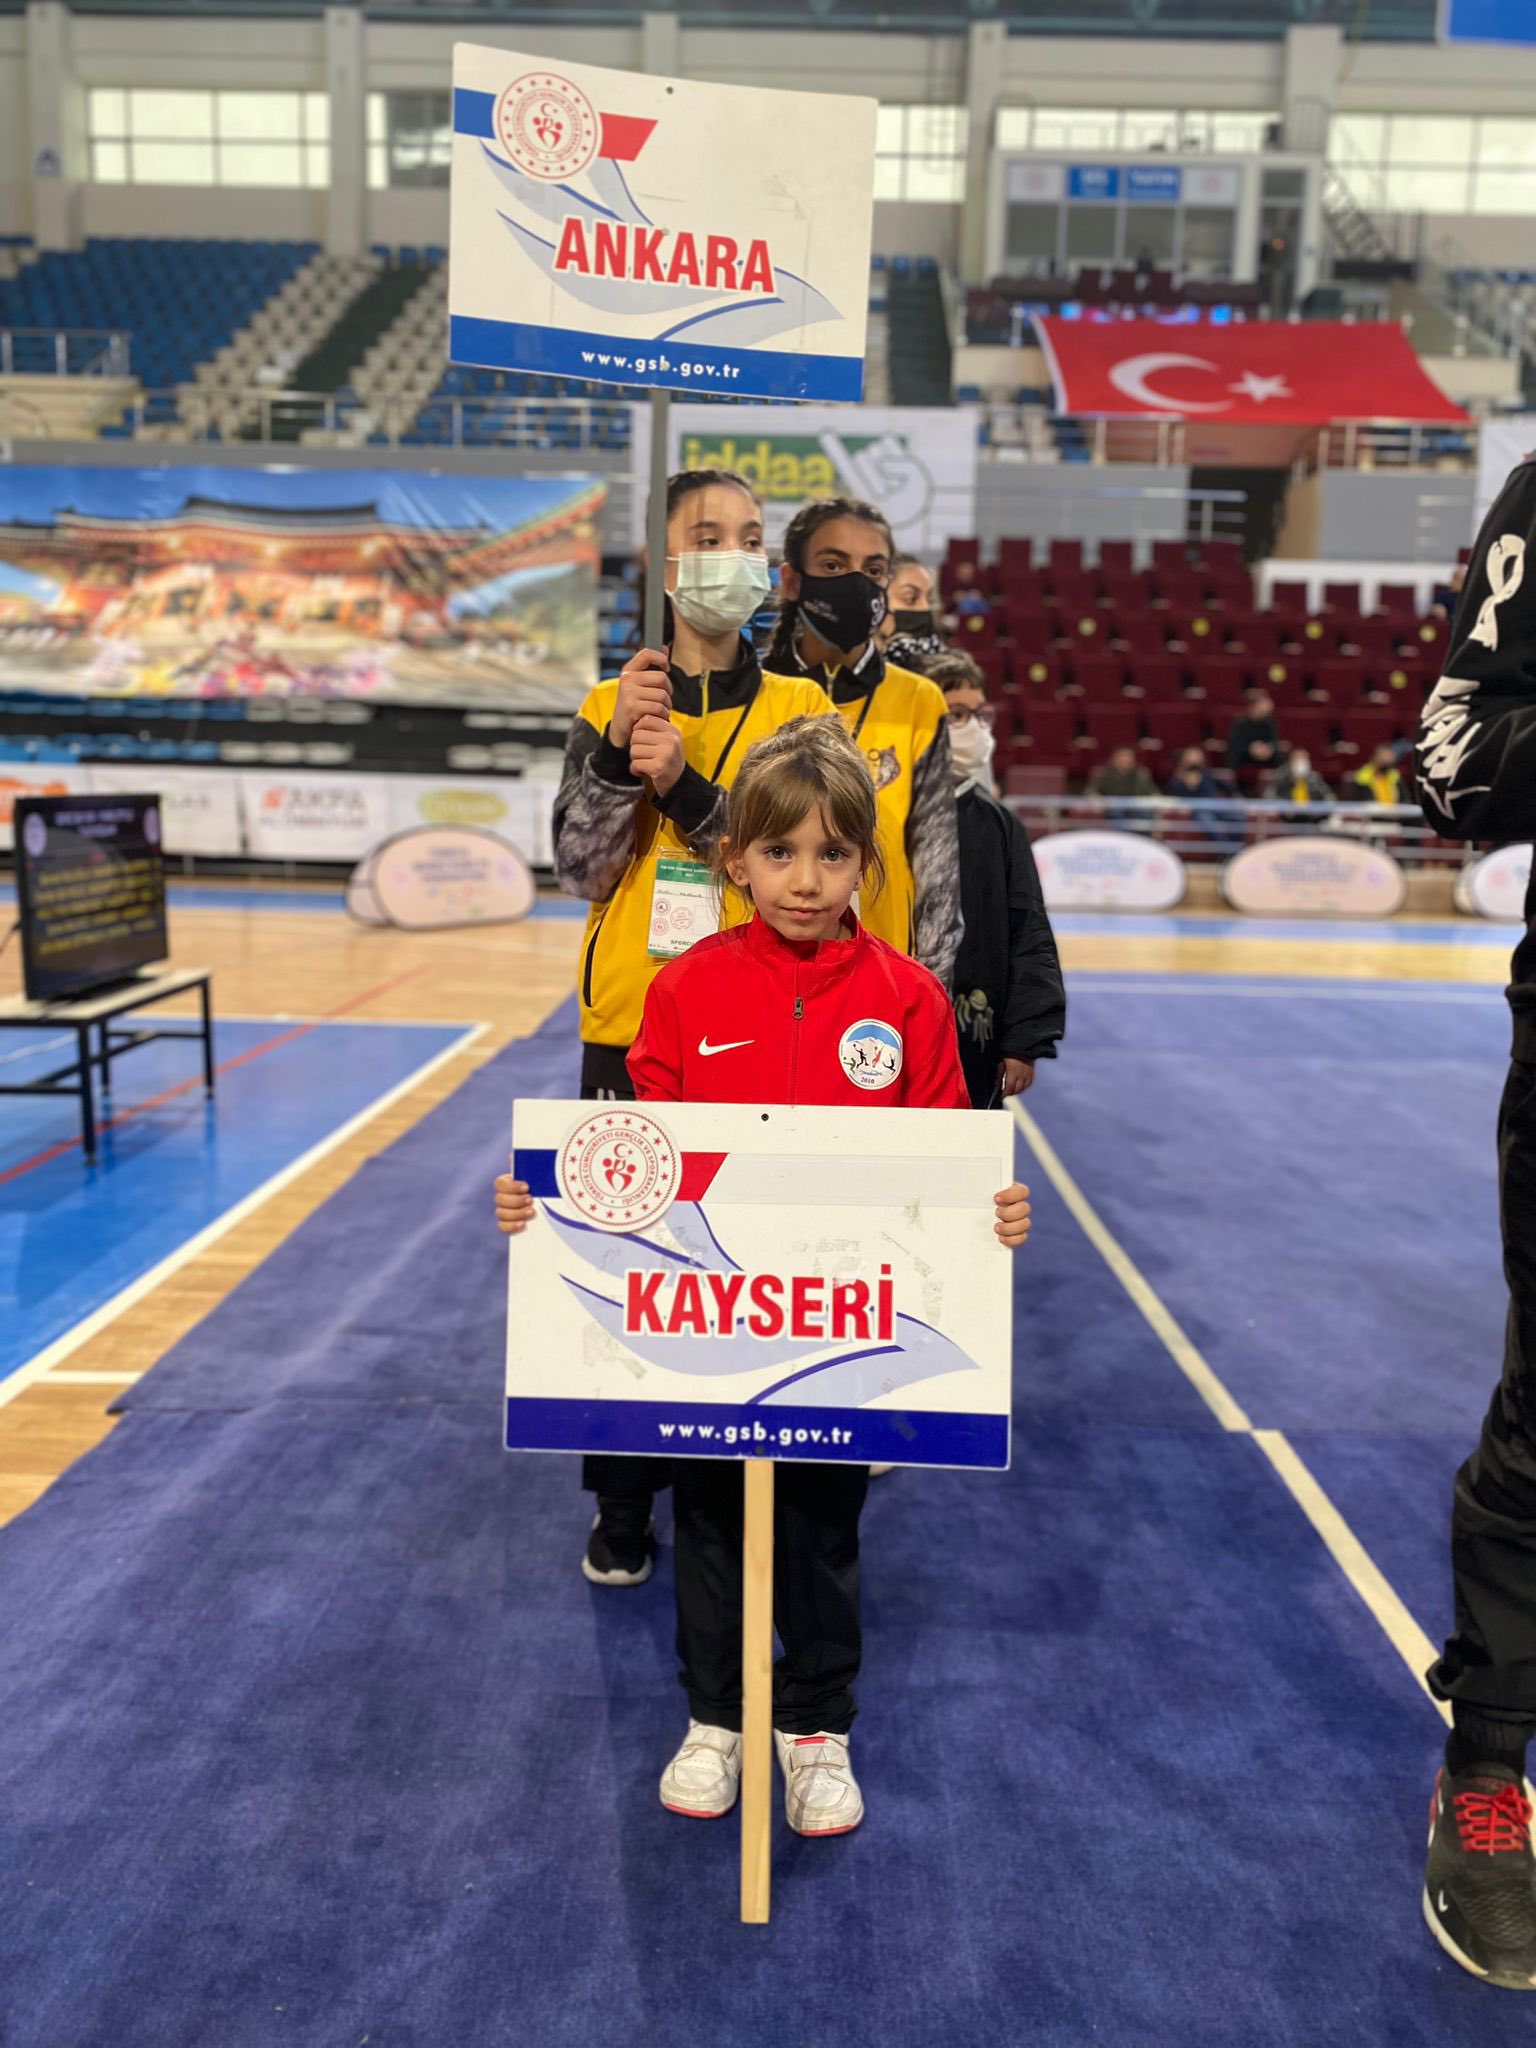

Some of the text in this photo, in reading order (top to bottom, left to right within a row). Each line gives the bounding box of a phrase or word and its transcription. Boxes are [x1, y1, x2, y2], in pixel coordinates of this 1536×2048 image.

[554, 217, 775, 293] ANKARA
[581, 351, 740, 379] www.gsb.gov.tr
[860, 1076, 875, 1084] 2010
[614, 1131, 645, 1146] GENÇLİK
[643, 1145, 652, 1154] VE
[647, 1155, 656, 1175] SPOR
[583, 1175, 604, 1201] TÜRKİYE
[626, 1264, 894, 1341] KAYSERİ
[658, 1421, 853, 1445] www.gsb.gov.tr
